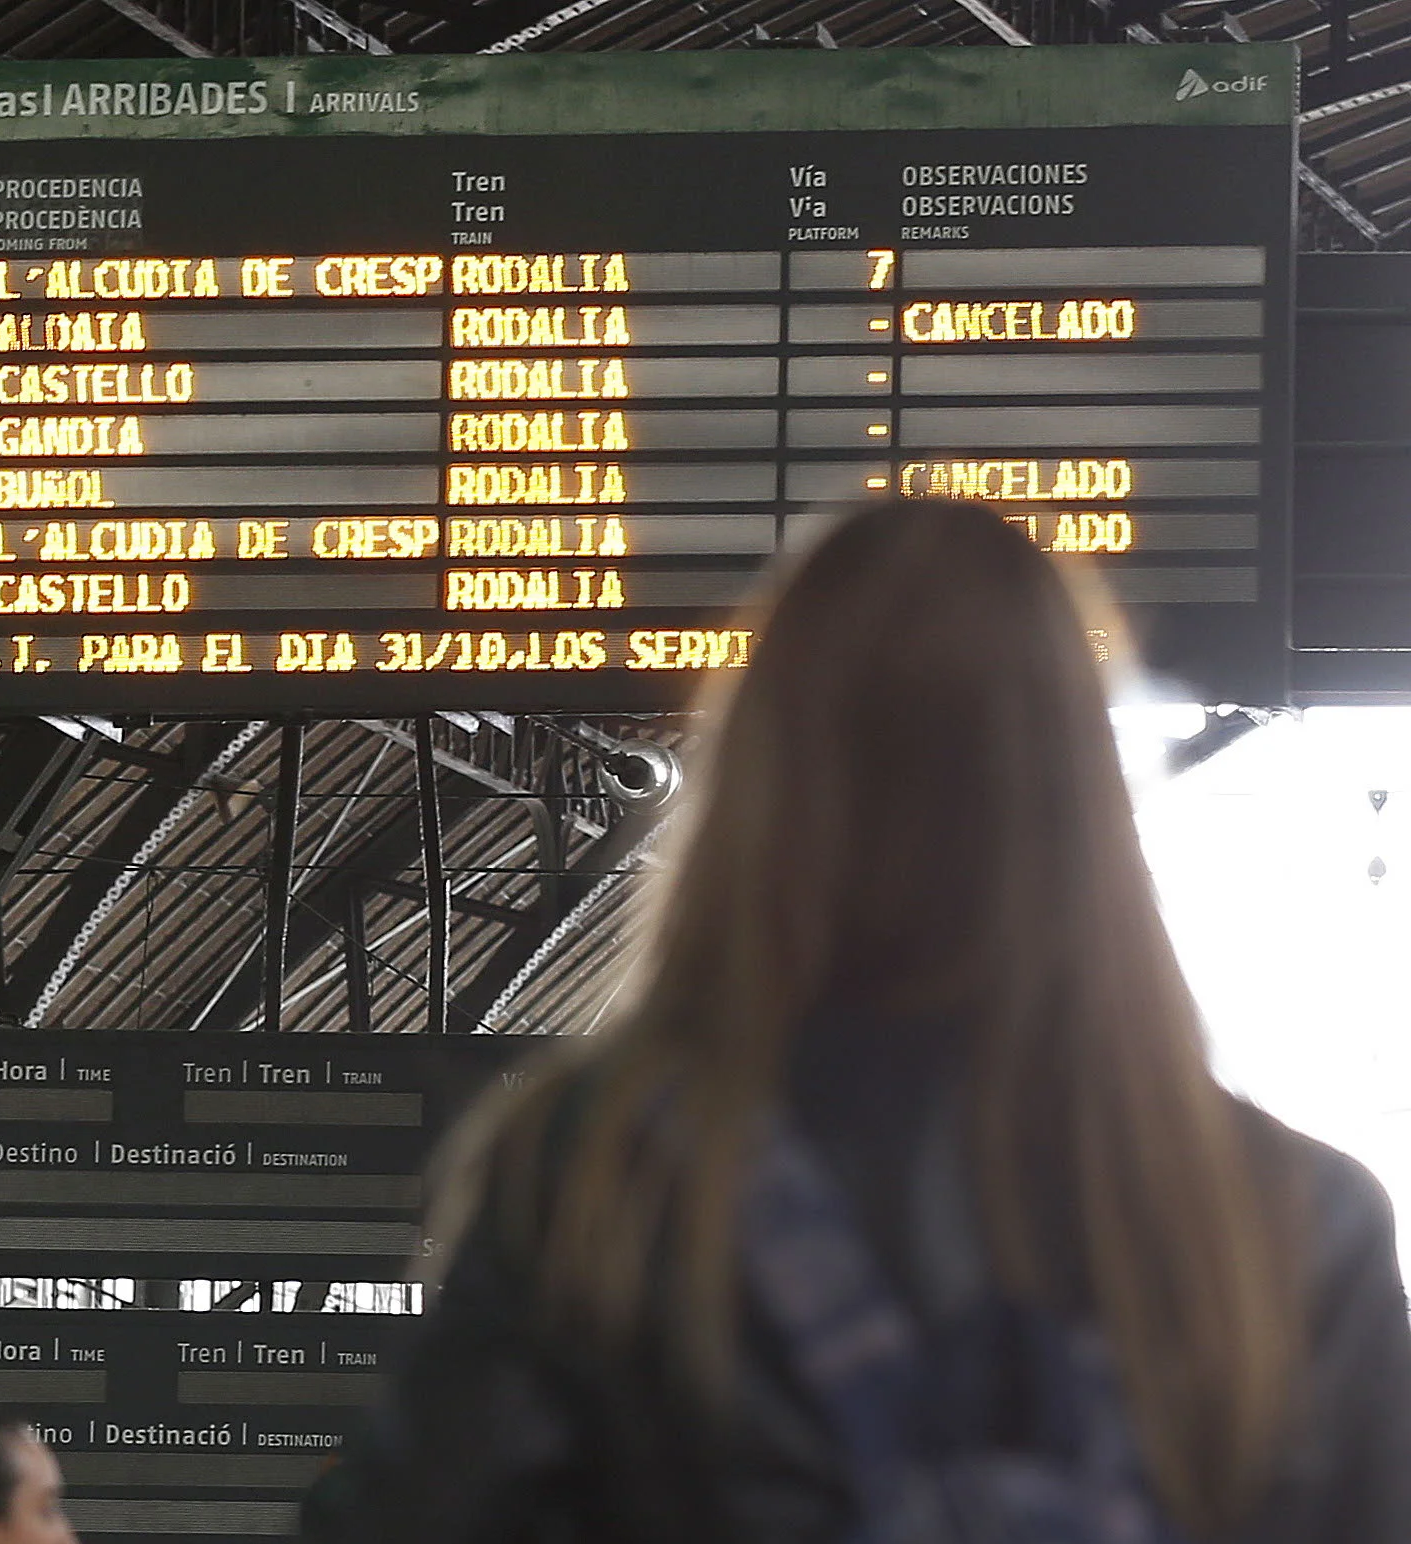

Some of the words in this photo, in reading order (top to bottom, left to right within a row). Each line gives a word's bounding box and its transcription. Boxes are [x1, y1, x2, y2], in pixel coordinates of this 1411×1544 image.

[1211, 75, 1268, 93] adif
[59, 80, 268, 116] ARRIBADES
[309, 91, 419, 113] ARRIVALS
[451, 171, 505, 192] Tren
[789, 164, 827, 187] Vía
[902, 163, 1088, 186] OBSERVACIONES
[451, 201, 505, 222] Tren
[902, 194, 1074, 217] OBSERVACIONS
[450, 231, 492, 245] TRAIN
[788, 227, 860, 241] PLATFORM
[901, 225, 970, 240] REMARKS
[241, 257, 294, 297] DE
[315, 256, 443, 296] CRESP
[451, 253, 629, 294] RODALIA
[867, 250, 894, 289] 7
[452, 306, 630, 347] RODALIA
[903, 300, 1135, 342] CANCELADO
[450, 359, 629, 400] RODALIA
[451, 411, 629, 452] RODALIA
[448, 465, 627, 505] RODALIA
[902, 460, 1131, 500] CANCELADO
[237, 521, 289, 559] DE
[312, 516, 440, 559] CRESP
[449, 517, 627, 557] RODALIA
[446, 571, 625, 611] RODALIA
[201, 634, 252, 672] EL
[276, 633, 357, 672] DIA
[76, 1068, 111, 1082] TIME
[182, 1062, 231, 1083] Tren
[258, 1063, 310, 1084] Tren
[342, 1072, 382, 1085] TRAIN
[111, 1143, 236, 1165] Destinació
[262, 1153, 347, 1167] DESTINATION
[70, 1349, 105, 1362] TIME
[177, 1342, 226, 1363] Tren
[253, 1344, 305, 1364] Tren
[337, 1352, 377, 1365] TRAIN
[106, 1423, 231, 1446] Destinació
